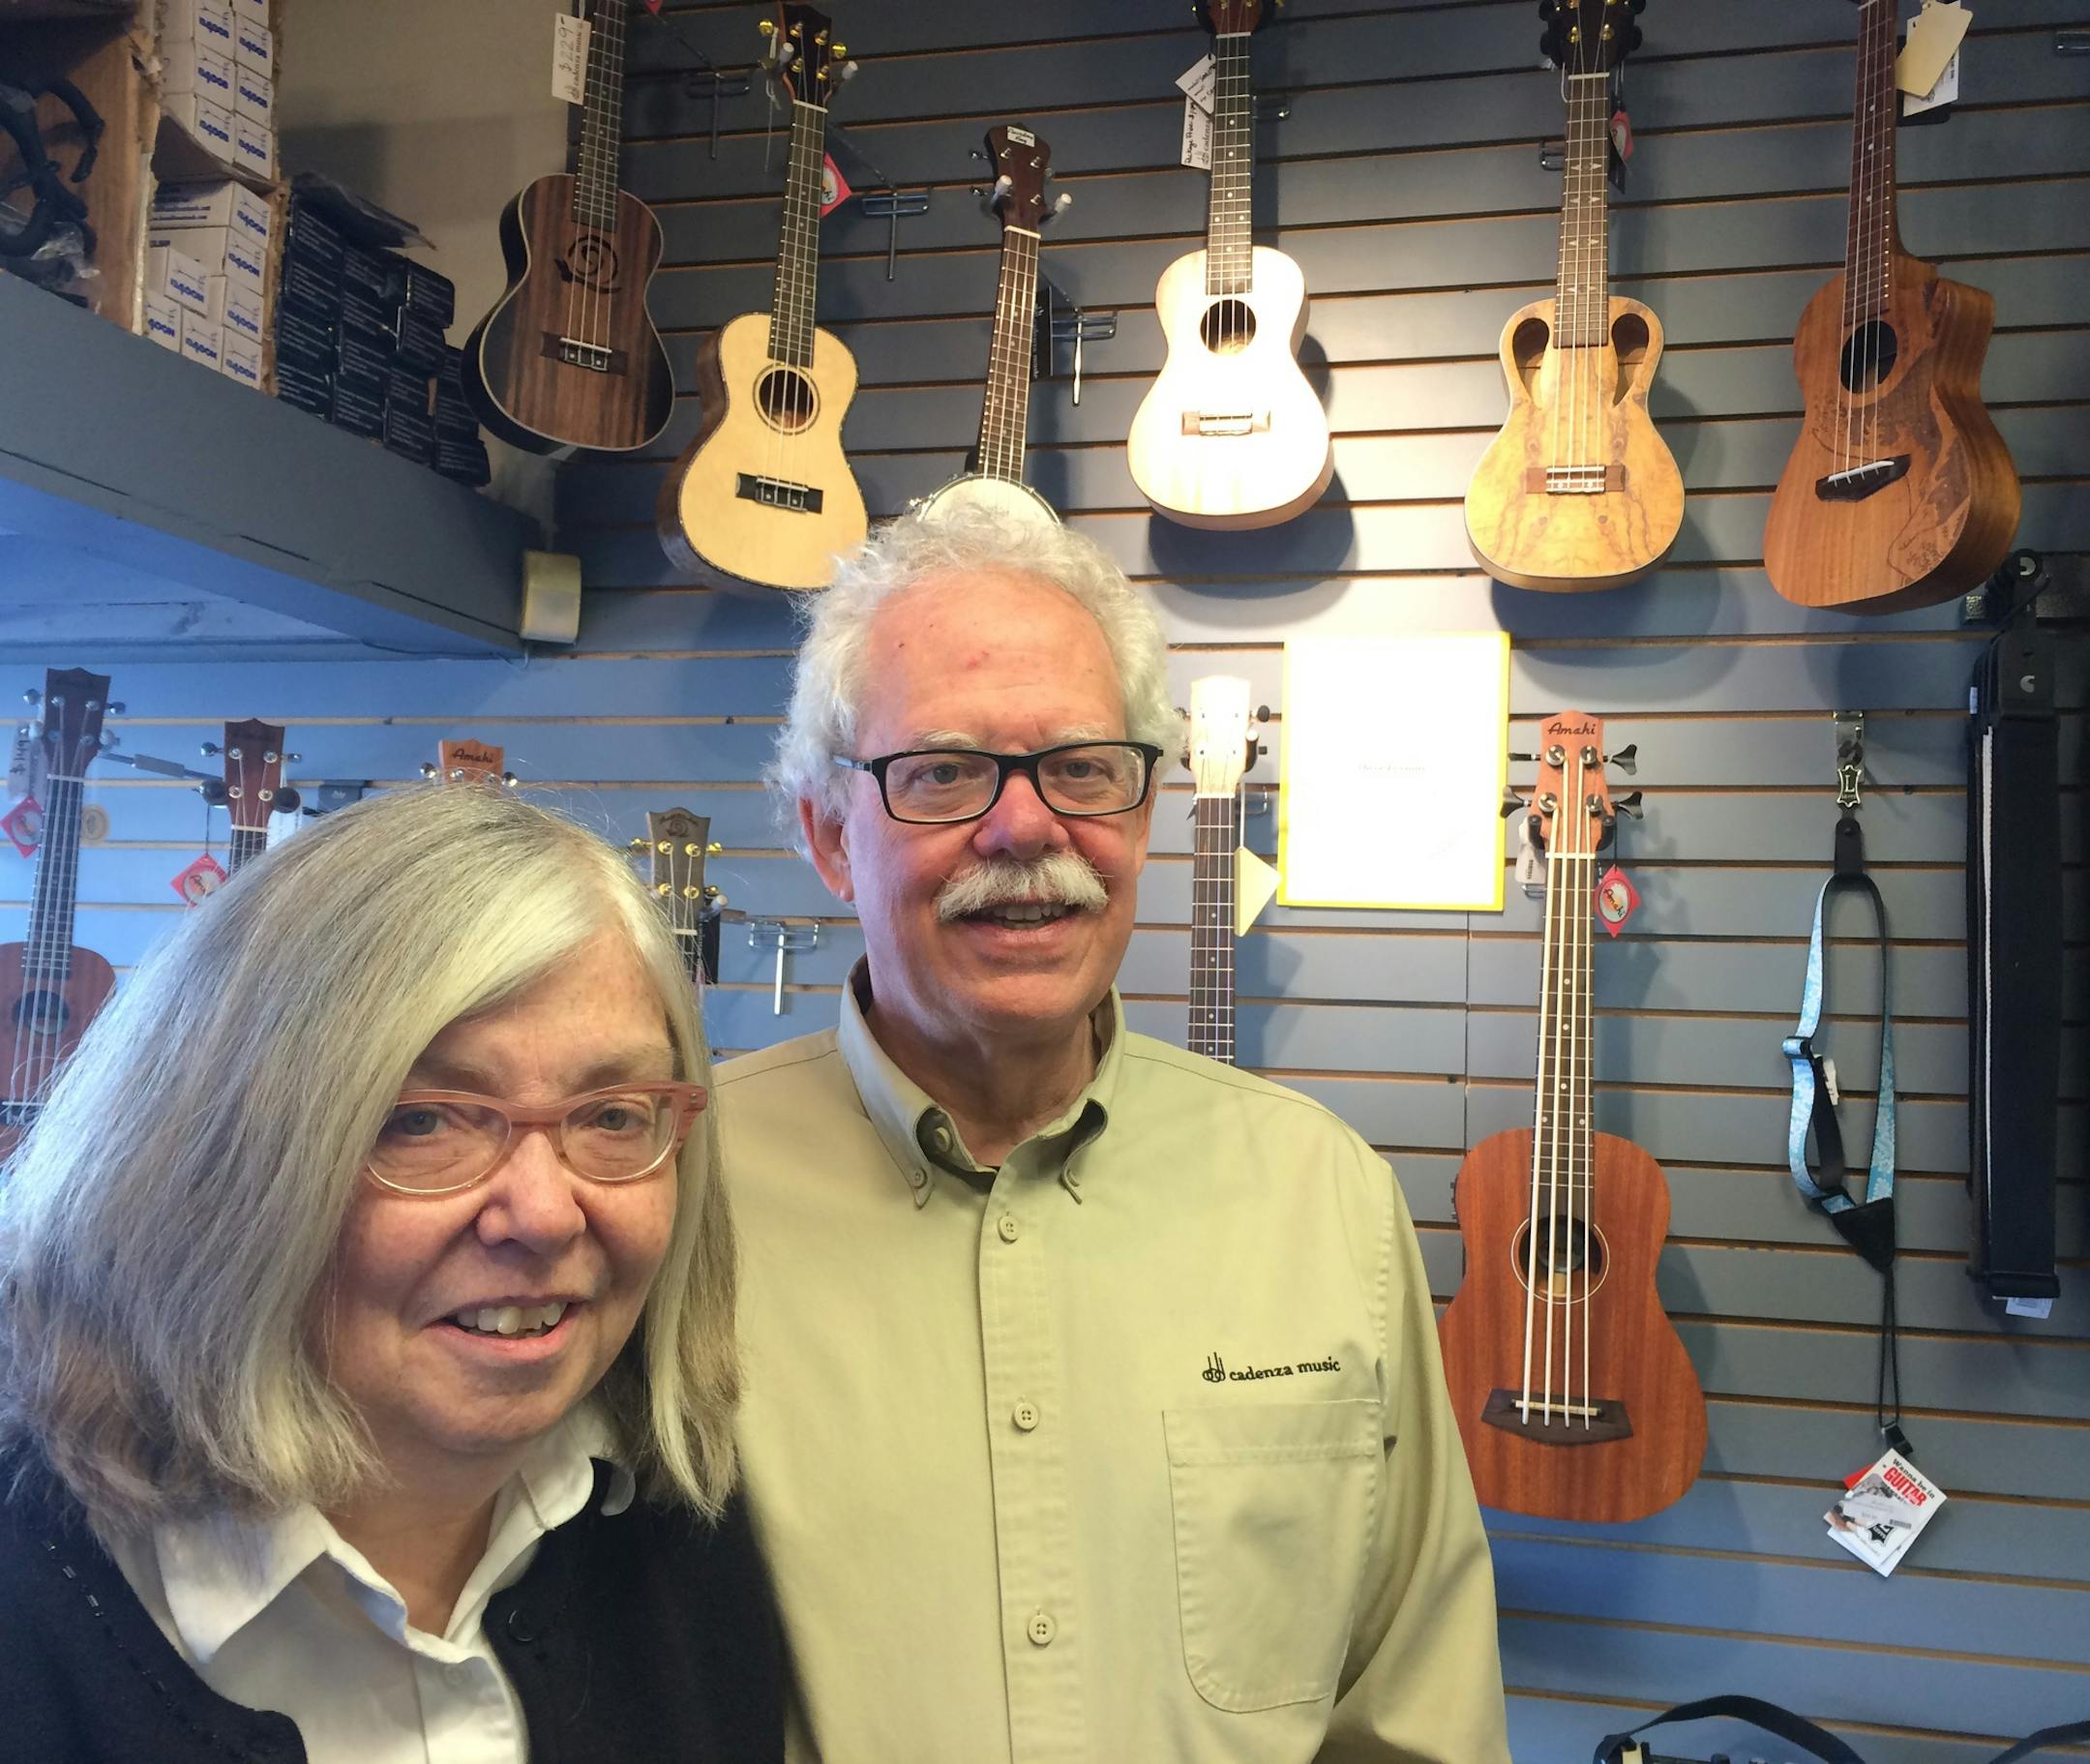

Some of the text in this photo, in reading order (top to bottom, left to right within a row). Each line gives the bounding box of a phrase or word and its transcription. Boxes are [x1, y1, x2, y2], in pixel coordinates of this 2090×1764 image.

[1547, 721, 1597, 736] Amahi
[452, 747, 494, 763] Amahi
[1602, 887, 1626, 918] Amahi
[1229, 1356, 1341, 1382] cadenza music
[1883, 1466, 1927, 1507] GUITAR
[1893, 1457, 1917, 1482] Wanna
[1917, 1480, 1926, 1492] be
[1926, 1489, 1935, 1500] in
